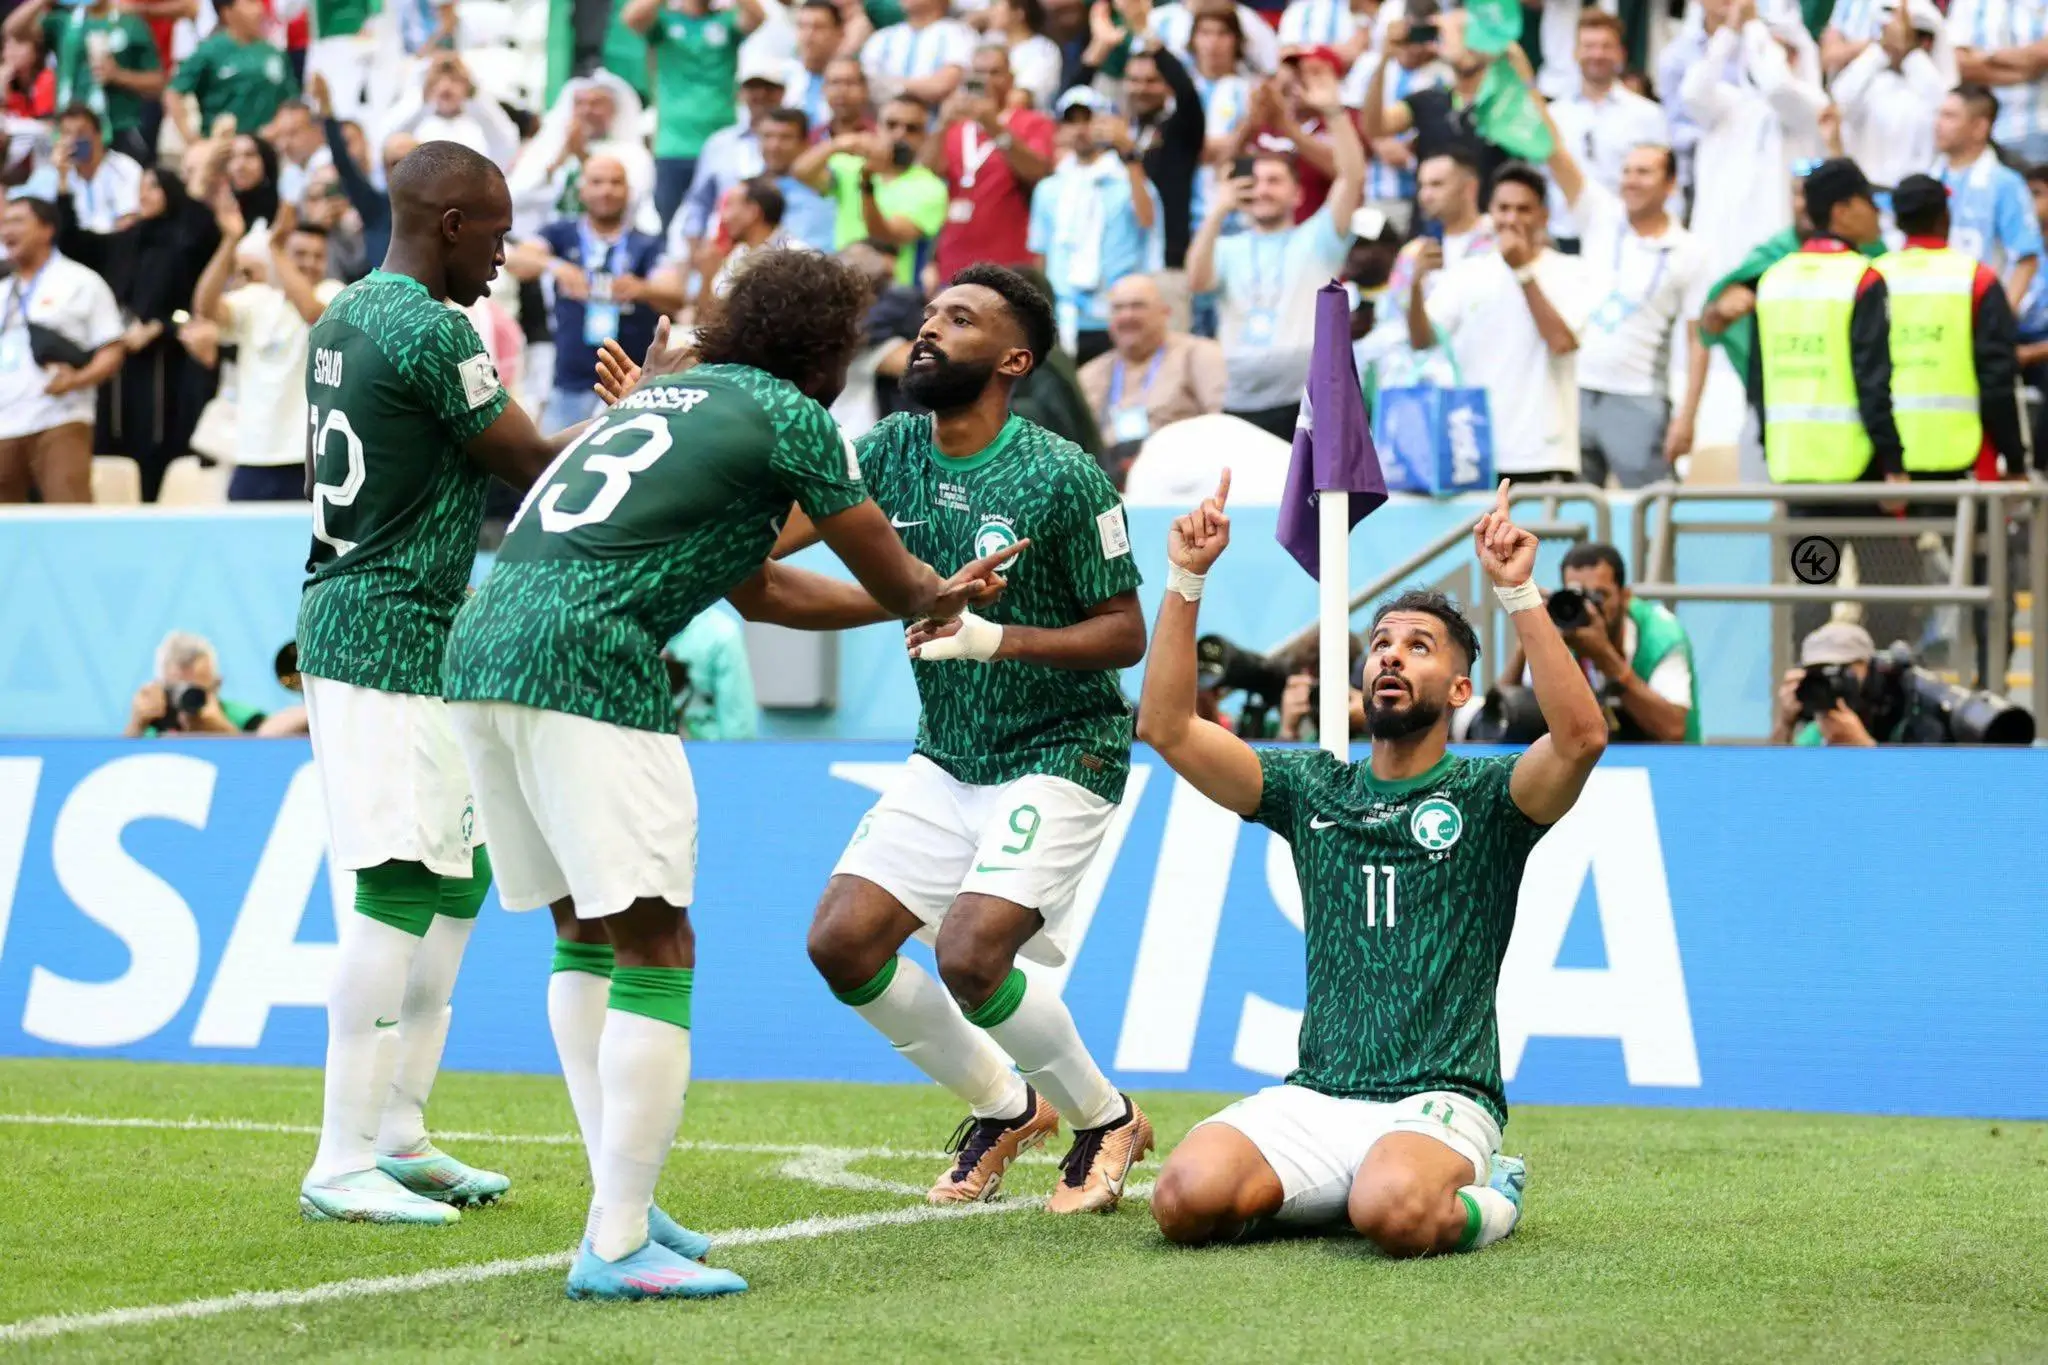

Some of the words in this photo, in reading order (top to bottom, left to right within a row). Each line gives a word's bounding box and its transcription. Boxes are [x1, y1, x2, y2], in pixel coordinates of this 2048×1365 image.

[314, 348, 342, 387] SAUD
[506, 413, 673, 533] 13
[1002, 804, 1041, 855] 9
[1362, 864, 1395, 928] 11
